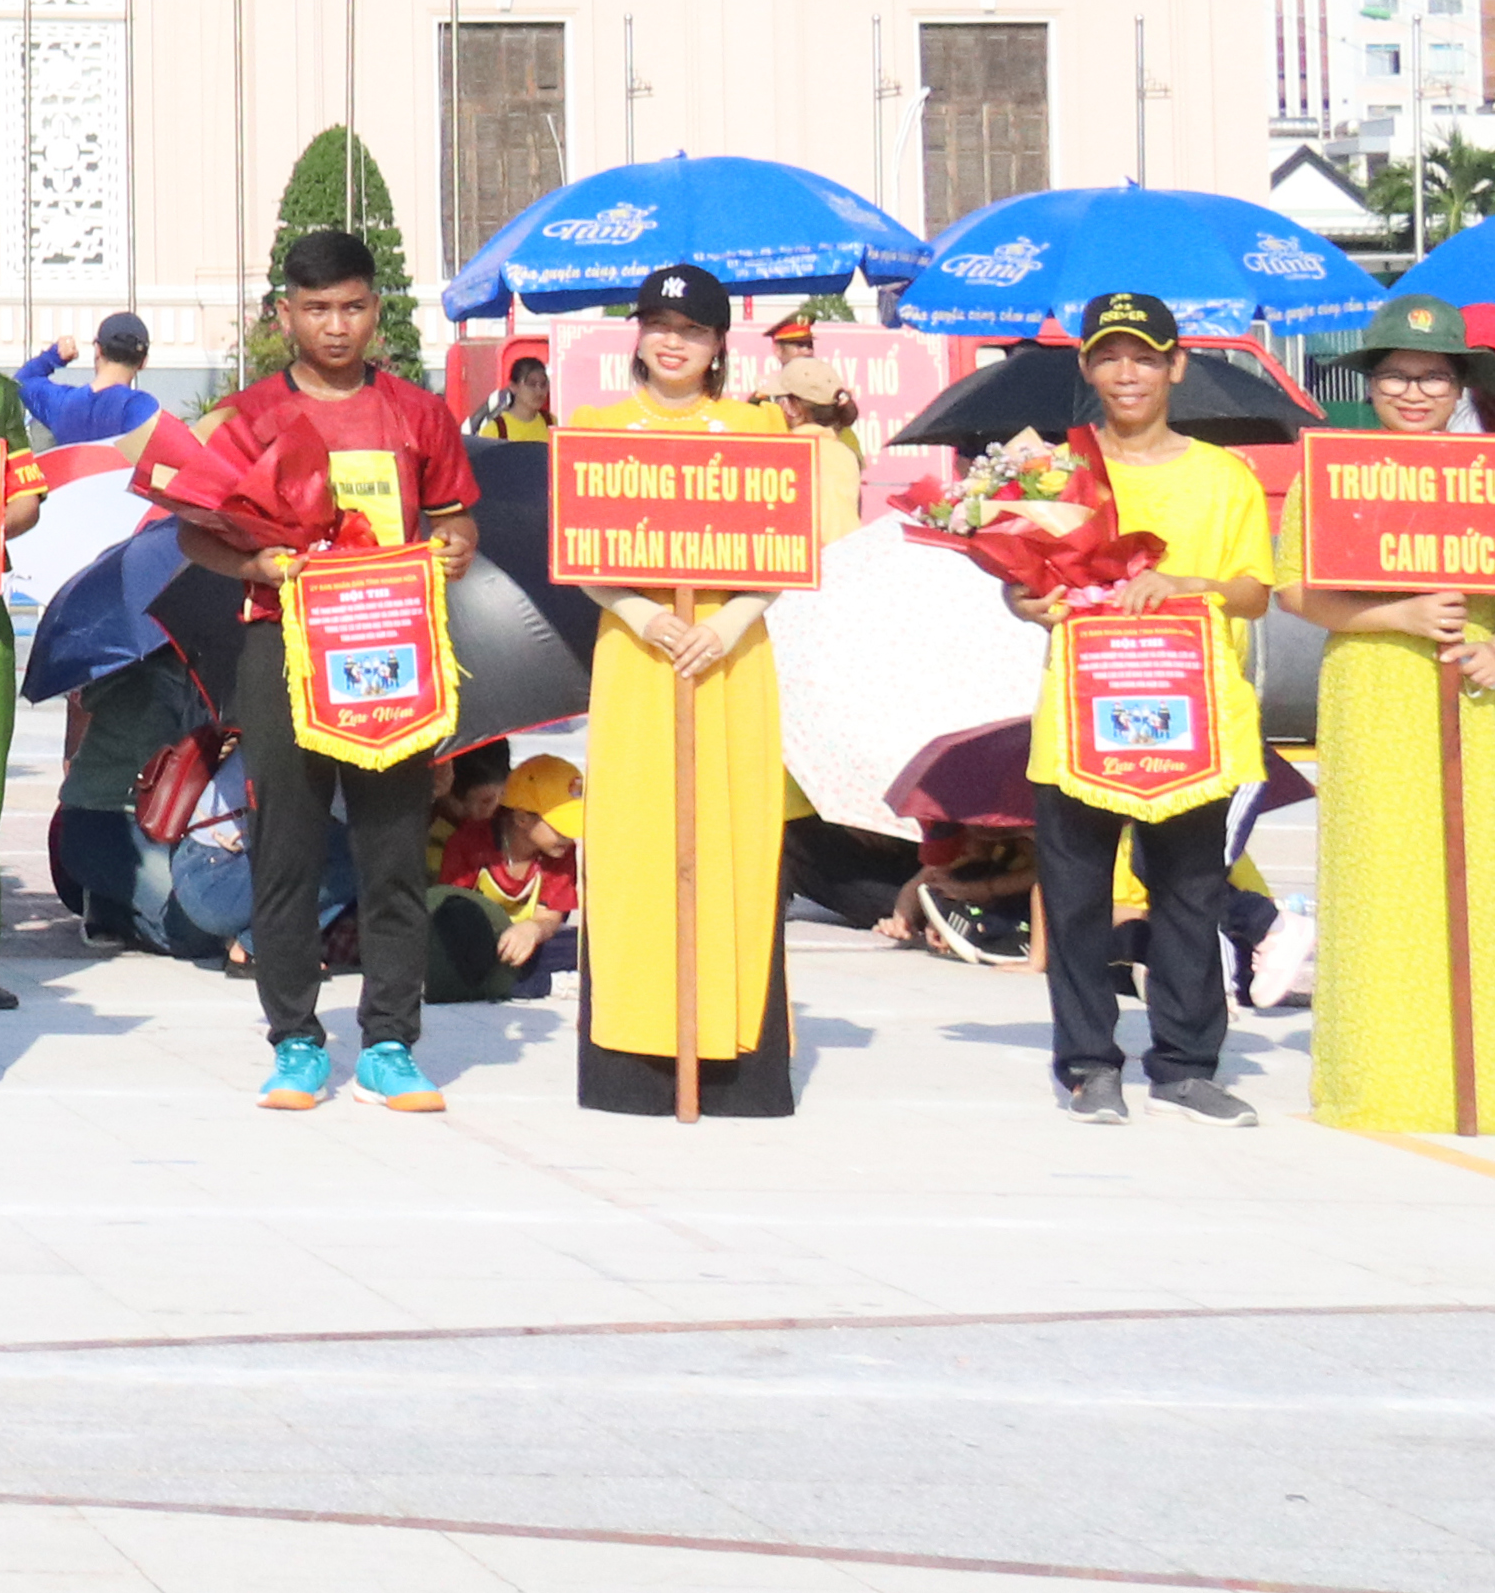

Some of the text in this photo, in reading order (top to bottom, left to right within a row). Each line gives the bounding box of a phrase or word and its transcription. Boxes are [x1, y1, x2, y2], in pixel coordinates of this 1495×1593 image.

[867, 343, 899, 396] NỔ
[572, 451, 797, 511] TRƯỜNG TIỂU HỌC
[1326, 456, 1437, 503] TRƯỜNG
[564, 516, 807, 575] THỊ TRẤN KHÁNH VĨNH
[1379, 527, 1495, 575] CAM ĐỨC
[339, 587, 391, 603] HỘI THI
